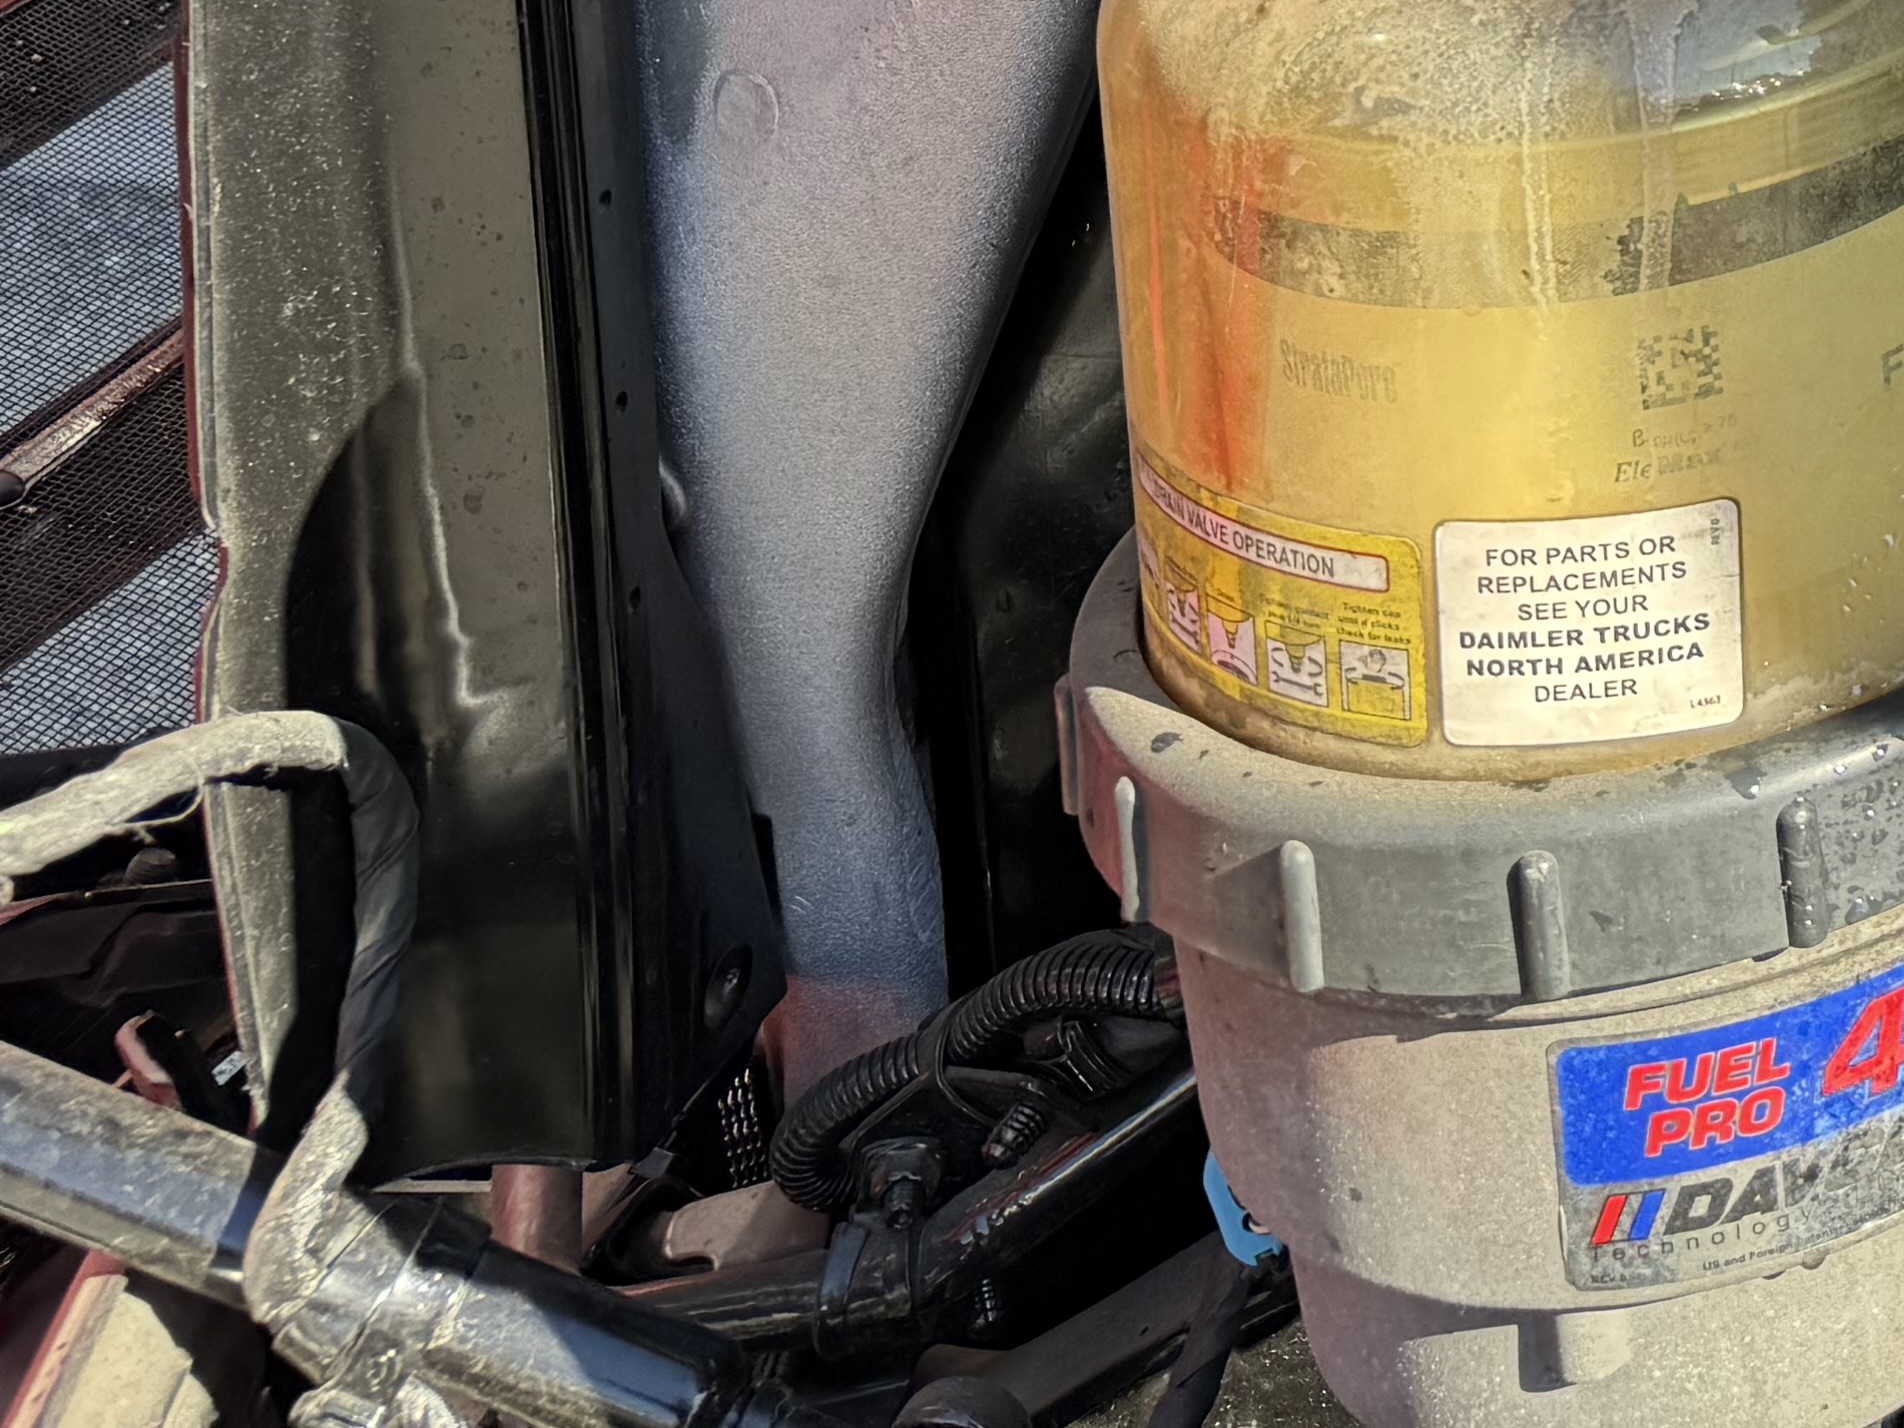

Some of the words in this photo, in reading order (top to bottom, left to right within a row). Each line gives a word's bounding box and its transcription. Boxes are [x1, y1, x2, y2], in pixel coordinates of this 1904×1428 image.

[1188, 509, 1231, 545] VALVE
[1232, 529, 1336, 579] OPERATION
[1485, 549, 1538, 567] FOR
[1546, 541, 1630, 565] PARTS
[1639, 535, 1676, 555] OR
[1477, 561, 1687, 594] REPLACEMENTS
[1518, 602, 1568, 621] SEE
[1575, 594, 1649, 618] YOUR
[1459, 629, 1583, 649] DAIMLER
[1594, 613, 1710, 645] TRUCKS
[1467, 657, 1563, 677] NORTH
[1574, 642, 1705, 673] AMERICA
[1535, 678, 1638, 703] DEALER
[1625, 1037, 1790, 1111] FUEL
[1645, 1086, 1785, 1158] PRO
[1703, 1259, 1720, 1271] US
[1723, 1253, 1746, 1268] and
